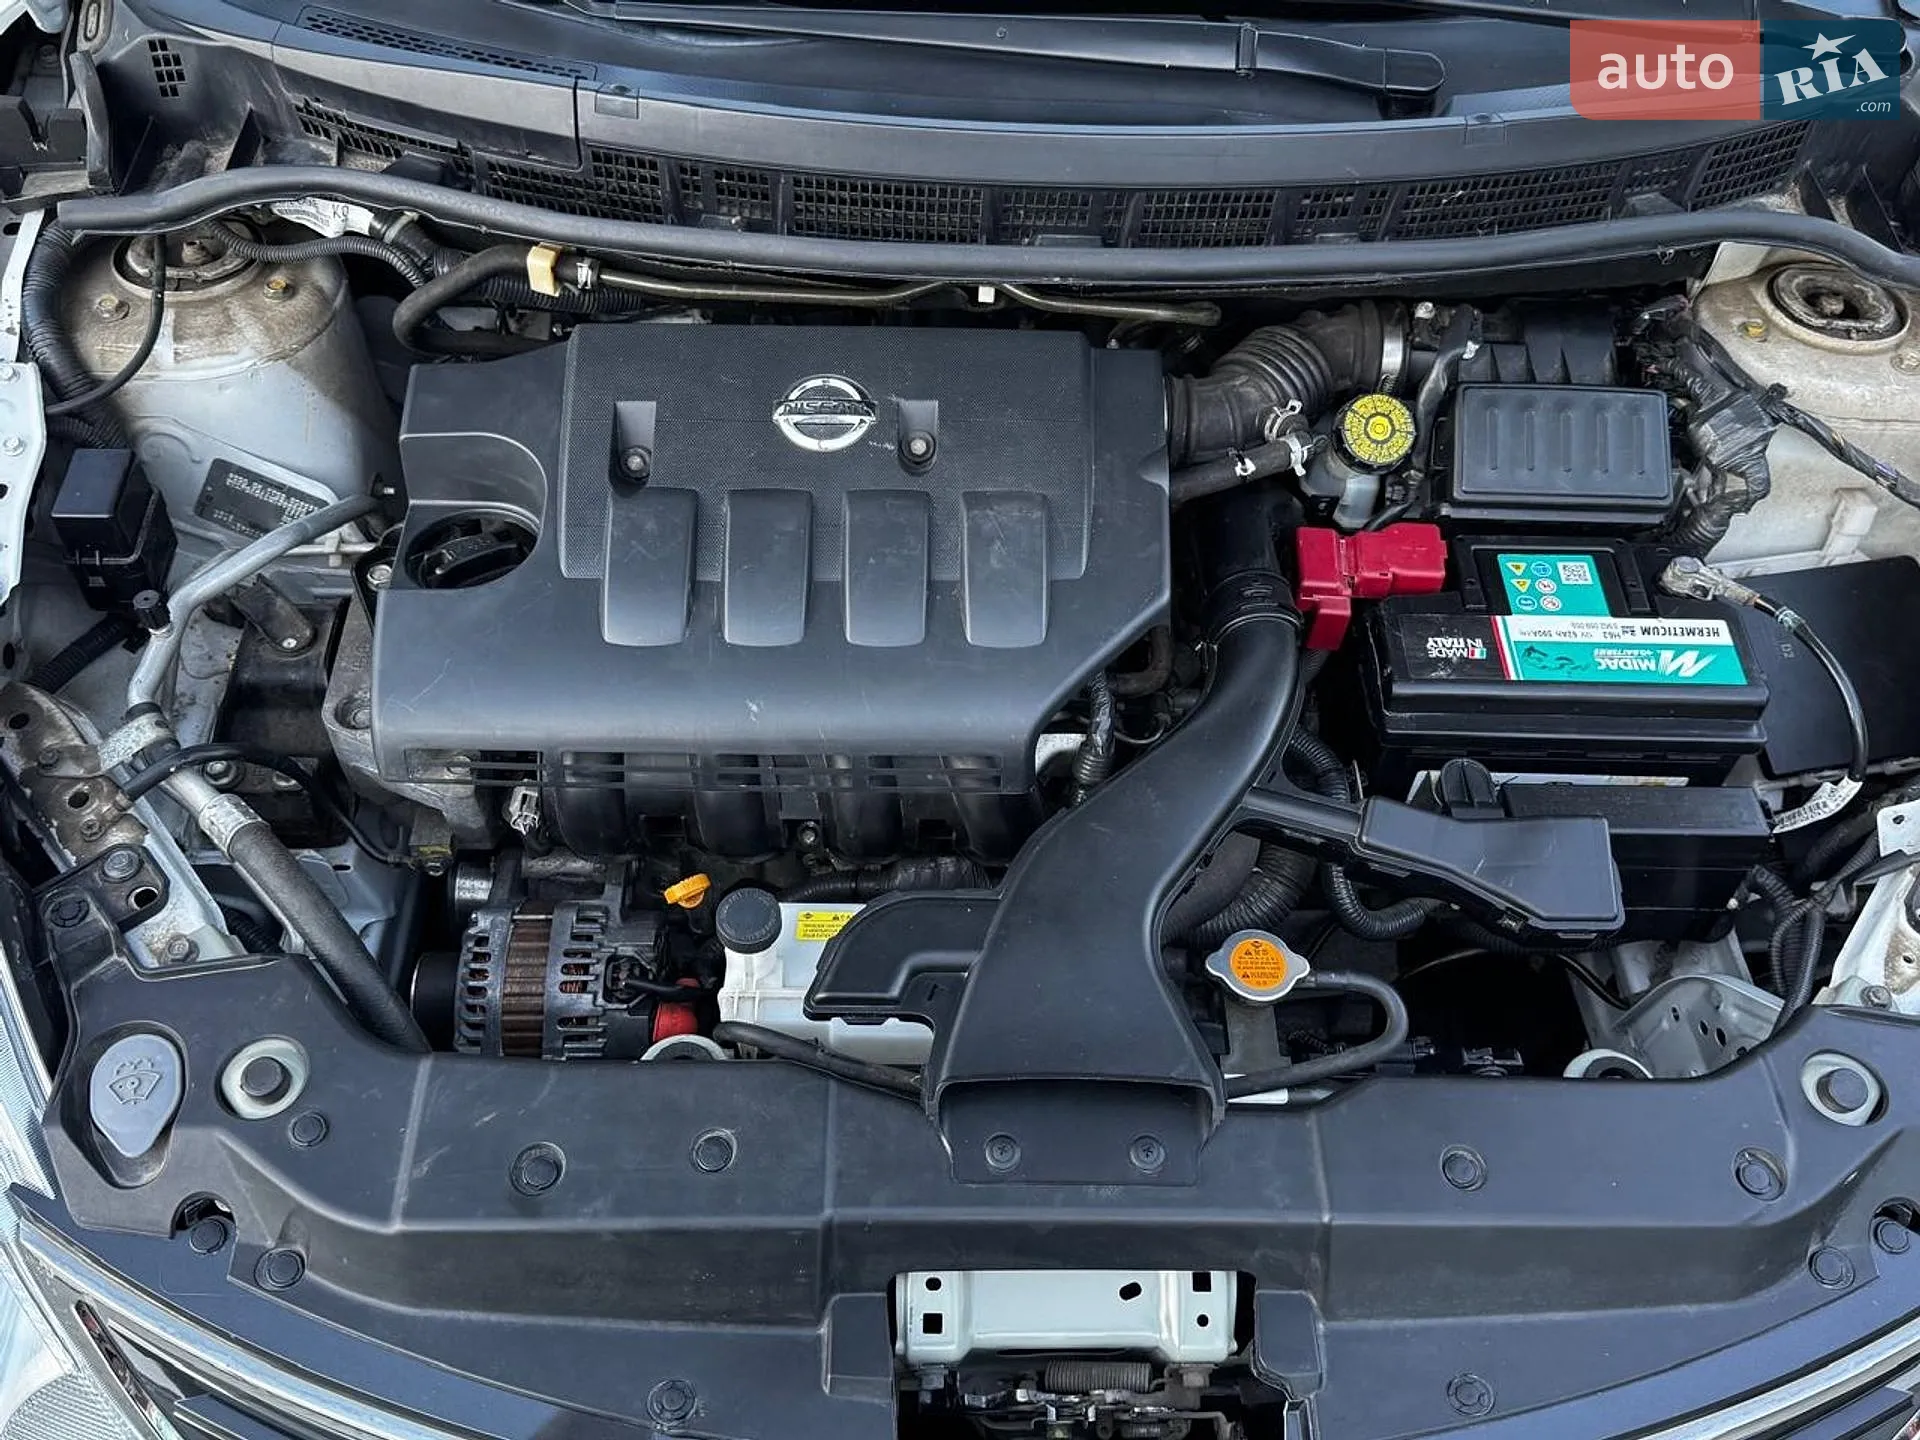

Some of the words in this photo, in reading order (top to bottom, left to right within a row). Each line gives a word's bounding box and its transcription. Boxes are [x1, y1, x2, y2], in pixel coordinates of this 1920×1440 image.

[783, 401, 868, 416] NISSAN
[1640, 626, 1720, 637] HERMETICUM
[1426, 637, 1465, 649] ITALY
[1466, 638, 1483, 648] IN
[1427, 647, 1468, 658] MADE
[1595, 657, 1656, 671] MIDAC
